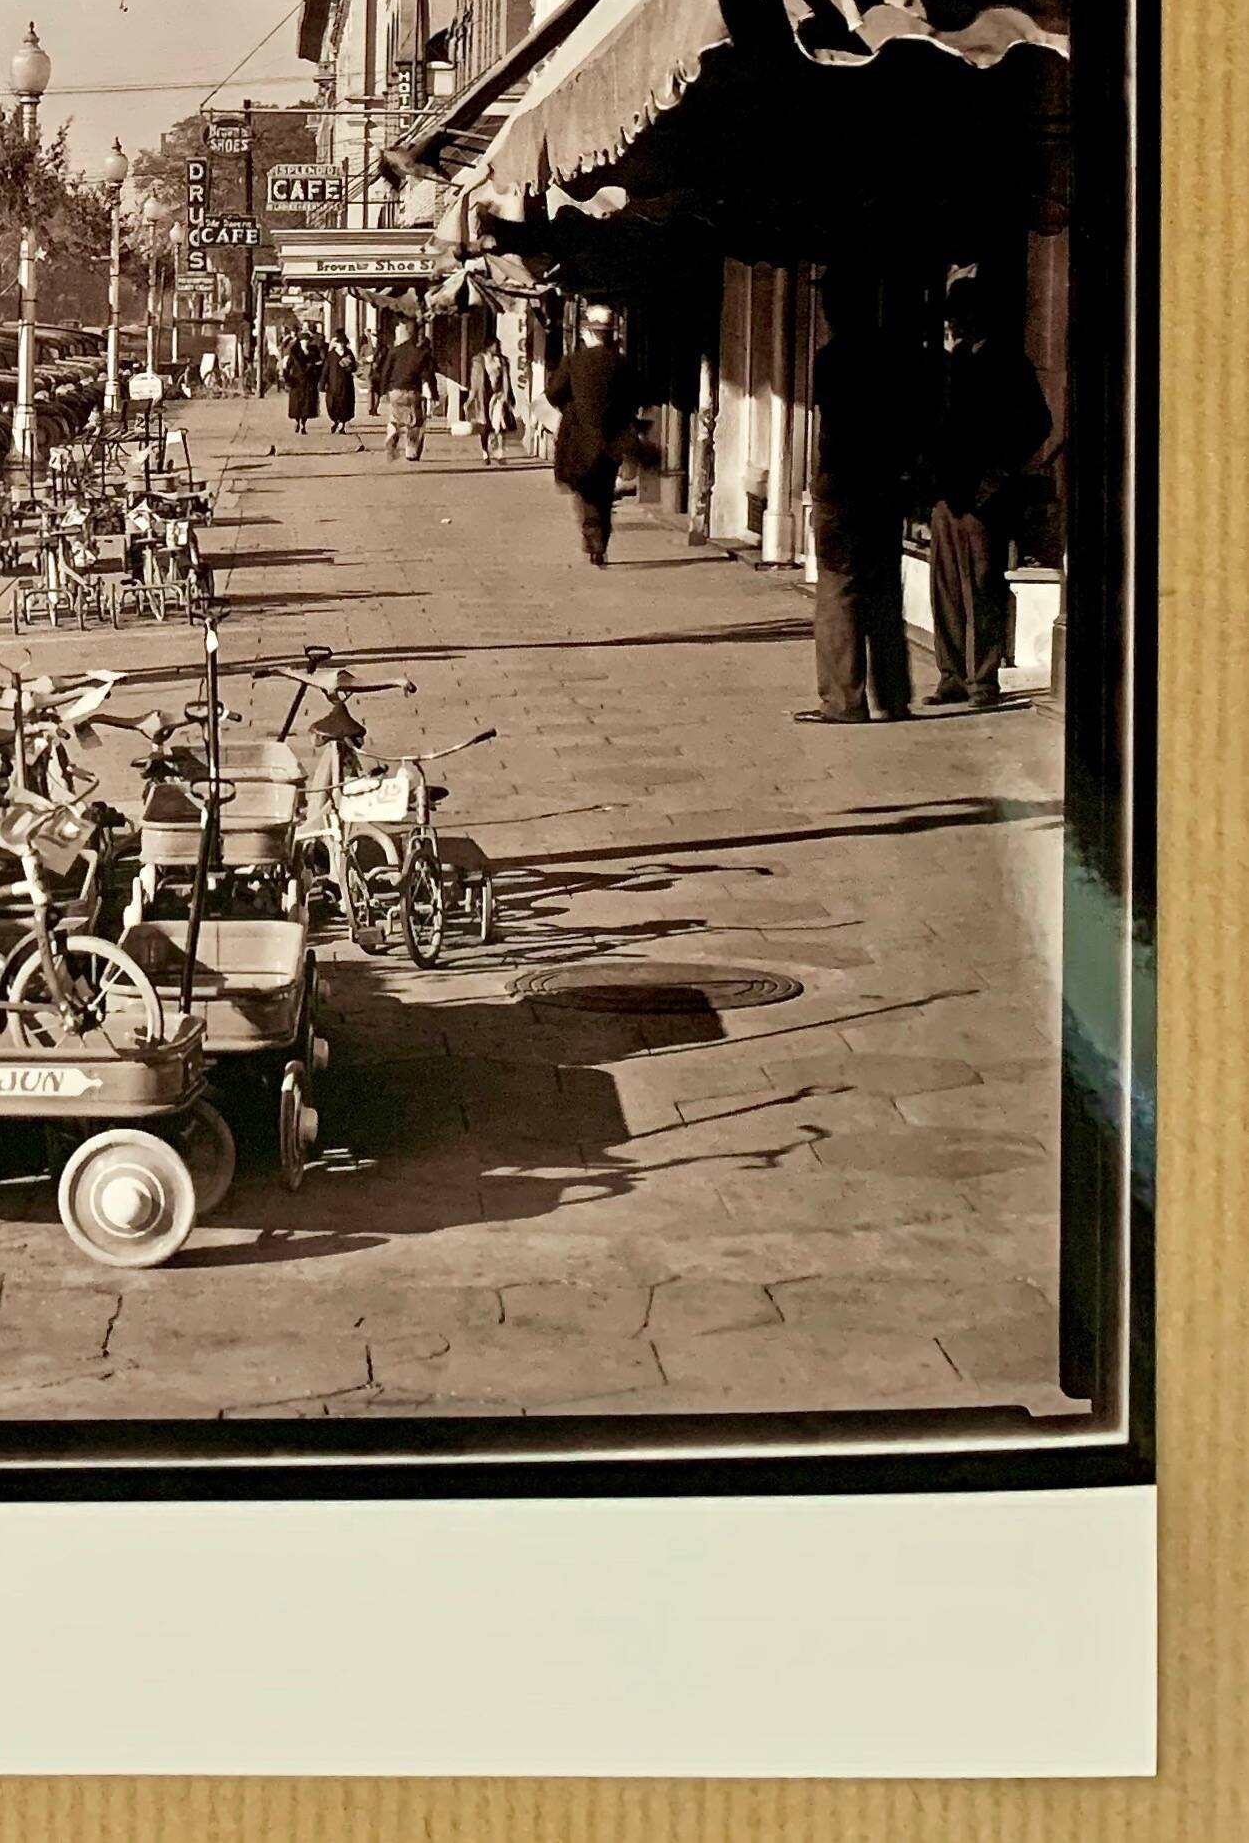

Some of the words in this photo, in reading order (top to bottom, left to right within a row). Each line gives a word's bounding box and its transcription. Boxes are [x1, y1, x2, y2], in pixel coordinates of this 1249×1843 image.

[209, 137, 251, 154] SHOES
[273, 179, 341, 201] CAFE
[200, 227, 259, 244] CAFE
[375, 259, 415, 272] Shoe
